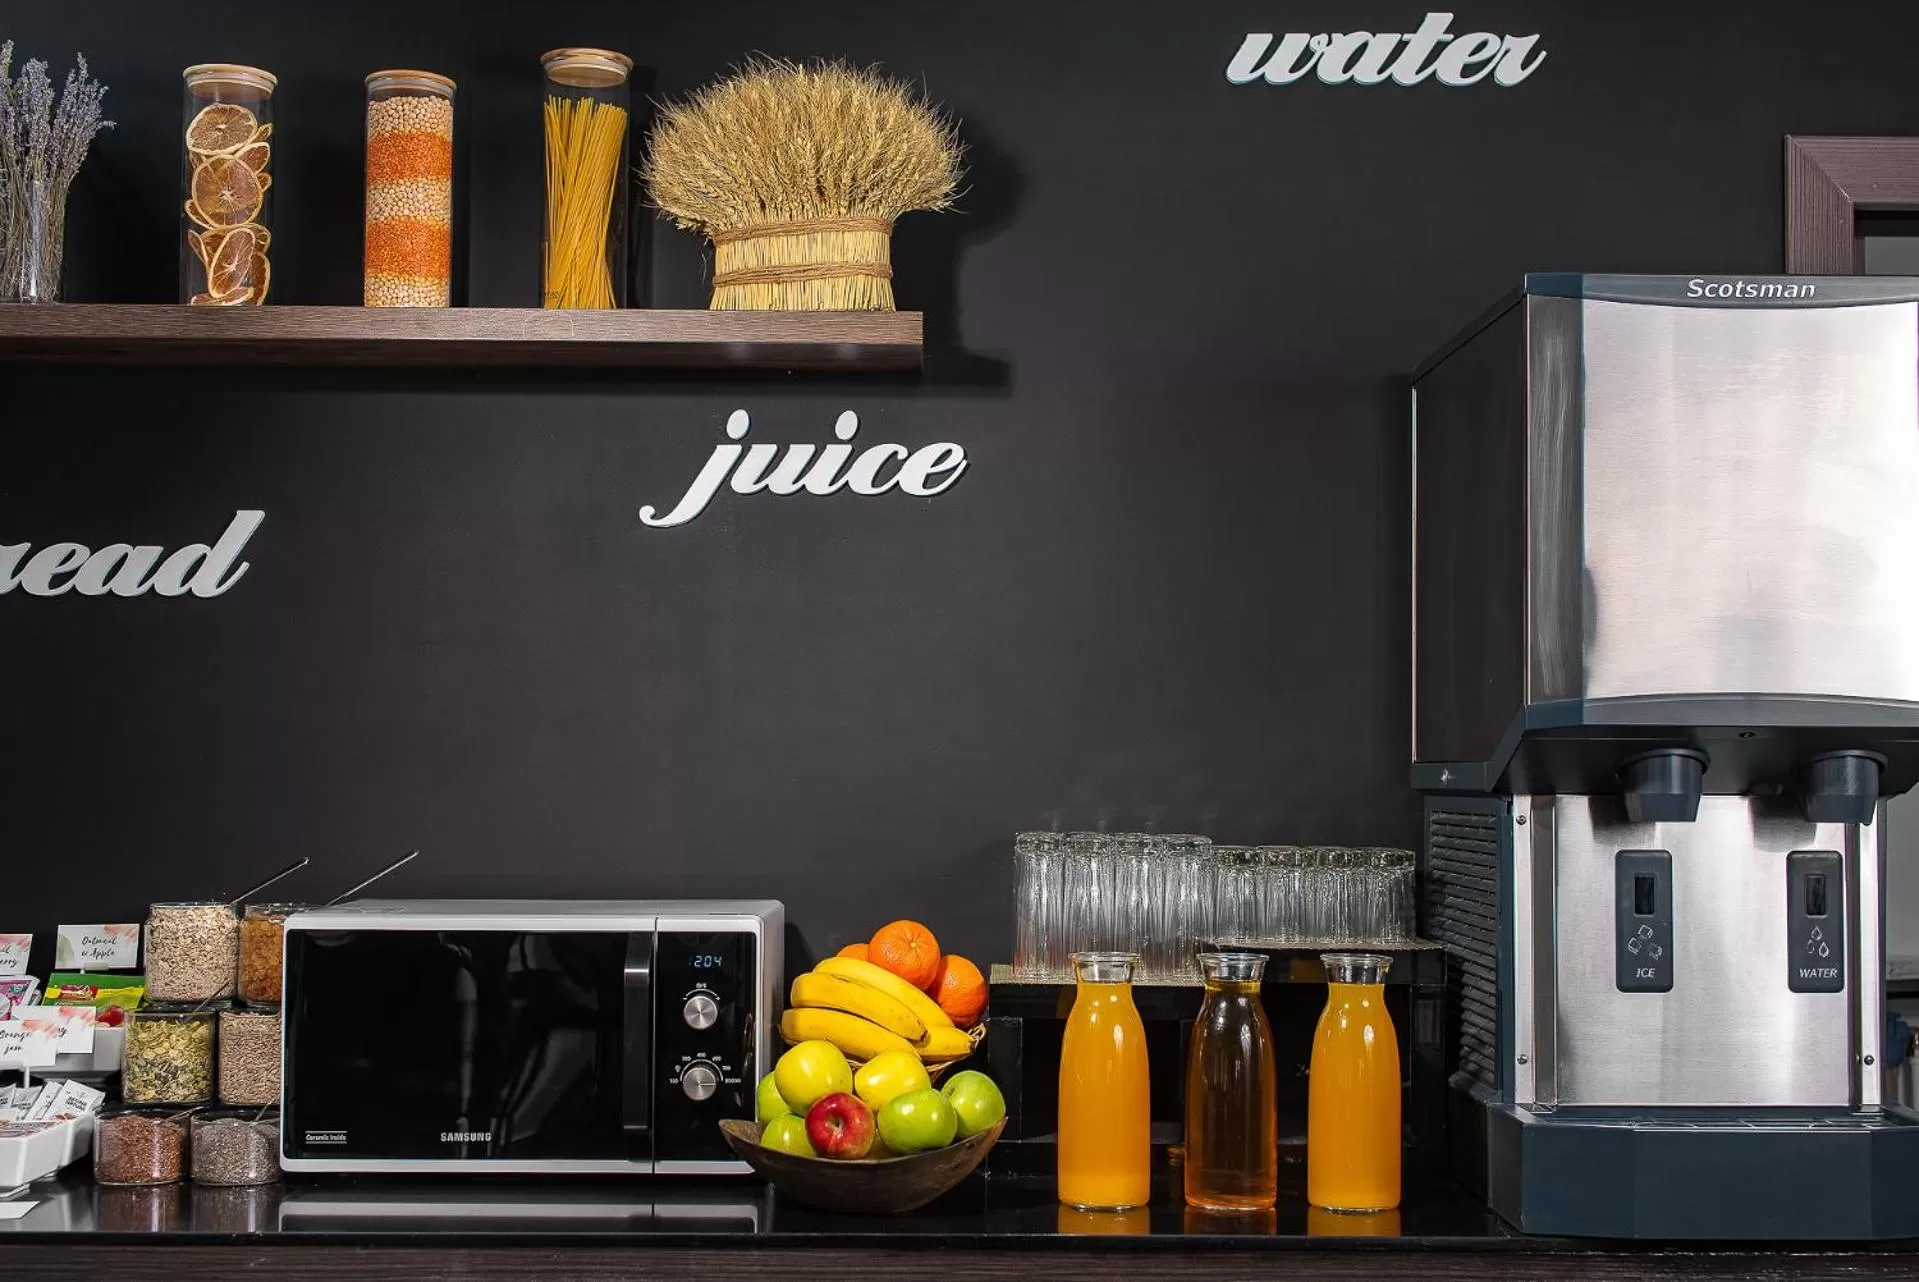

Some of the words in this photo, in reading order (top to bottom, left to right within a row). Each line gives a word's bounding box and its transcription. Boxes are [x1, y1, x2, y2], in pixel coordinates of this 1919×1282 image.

[1226, 12, 1548, 87] water
[1687, 278, 1816, 298] Scotsman
[638, 408, 968, 528] juice
[81, 936, 117, 946] Oatmeal
[89, 947, 115, 960] Apple
[1636, 967, 1656, 979] ICE
[1800, 967, 1838, 979] WATER
[440, 1132, 492, 1142] SAMSUNG
